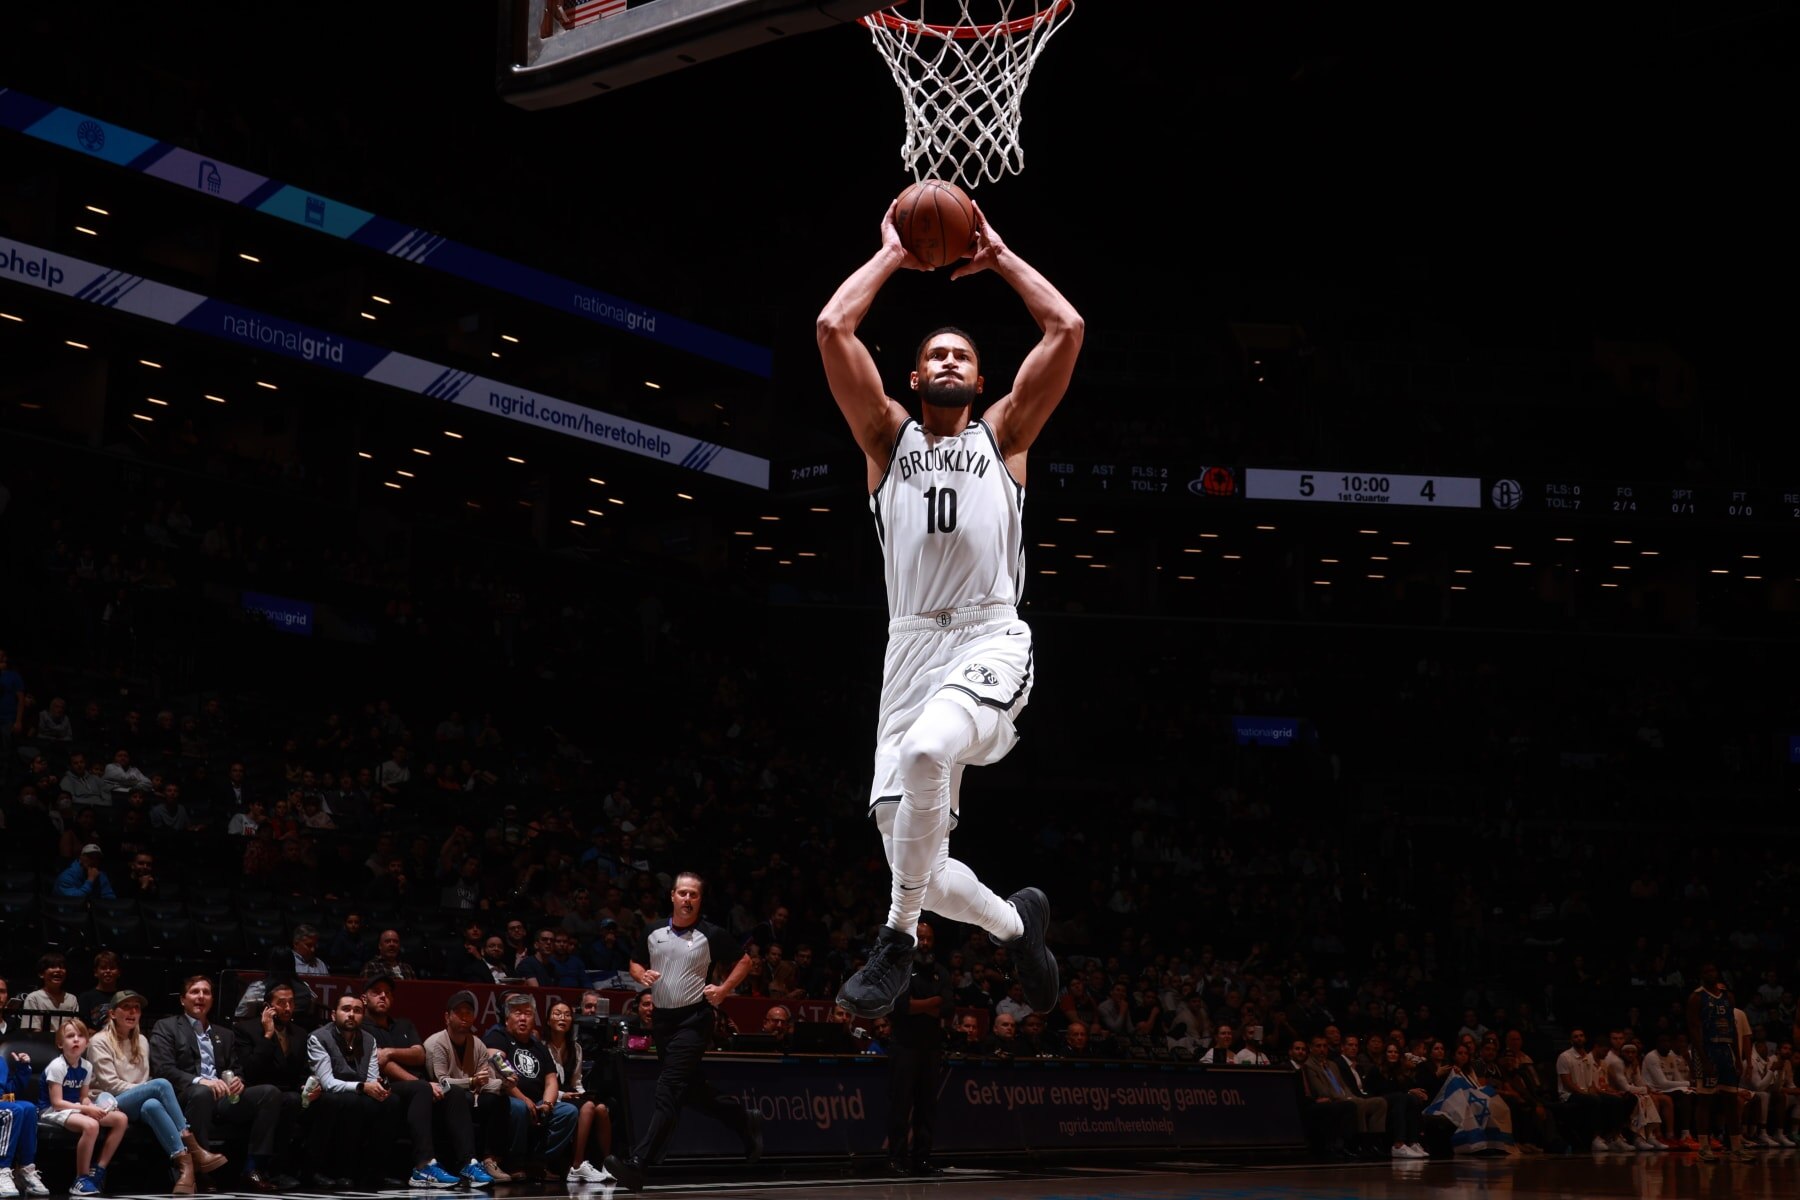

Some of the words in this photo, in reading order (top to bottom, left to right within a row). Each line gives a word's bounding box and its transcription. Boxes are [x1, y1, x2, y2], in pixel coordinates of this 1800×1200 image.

[573, 291, 656, 334] nationalgrid
[222, 310, 345, 364] nationalgrid
[489, 390, 671, 458] ngrid.com/heretohelp
[791, 467, 811, 481] 7:47
[812, 464, 828, 477] PM
[898, 447, 991, 481] BROOKLYN
[1049, 463, 1074, 473] REB
[1091, 464, 1116, 475] AST
[1059, 477, 1065, 488] 1
[1101, 479, 1107, 489] 1
[1299, 474, 1315, 497] 5
[1341, 475, 1390, 493] 10:00
[1420, 480, 1436, 502] 4
[1616, 486, 1633, 498] FG
[1338, 493, 1352, 502] 1st
[1354, 493, 1390, 503] Quarter
[923, 486, 958, 534] 10
[1237, 727, 1293, 740] nationalgrid
[732, 1082, 866, 1129] tionalgrid
[964, 1079, 999, 1105] Get
[1003, 1083, 1045, 1111] your
[1050, 1081, 1171, 1112] energy-saving
[1174, 1087, 1218, 1112] game
[1221, 1088, 1246, 1106] on.
[1059, 1115, 1175, 1137] ngrid.com/heretohelp
